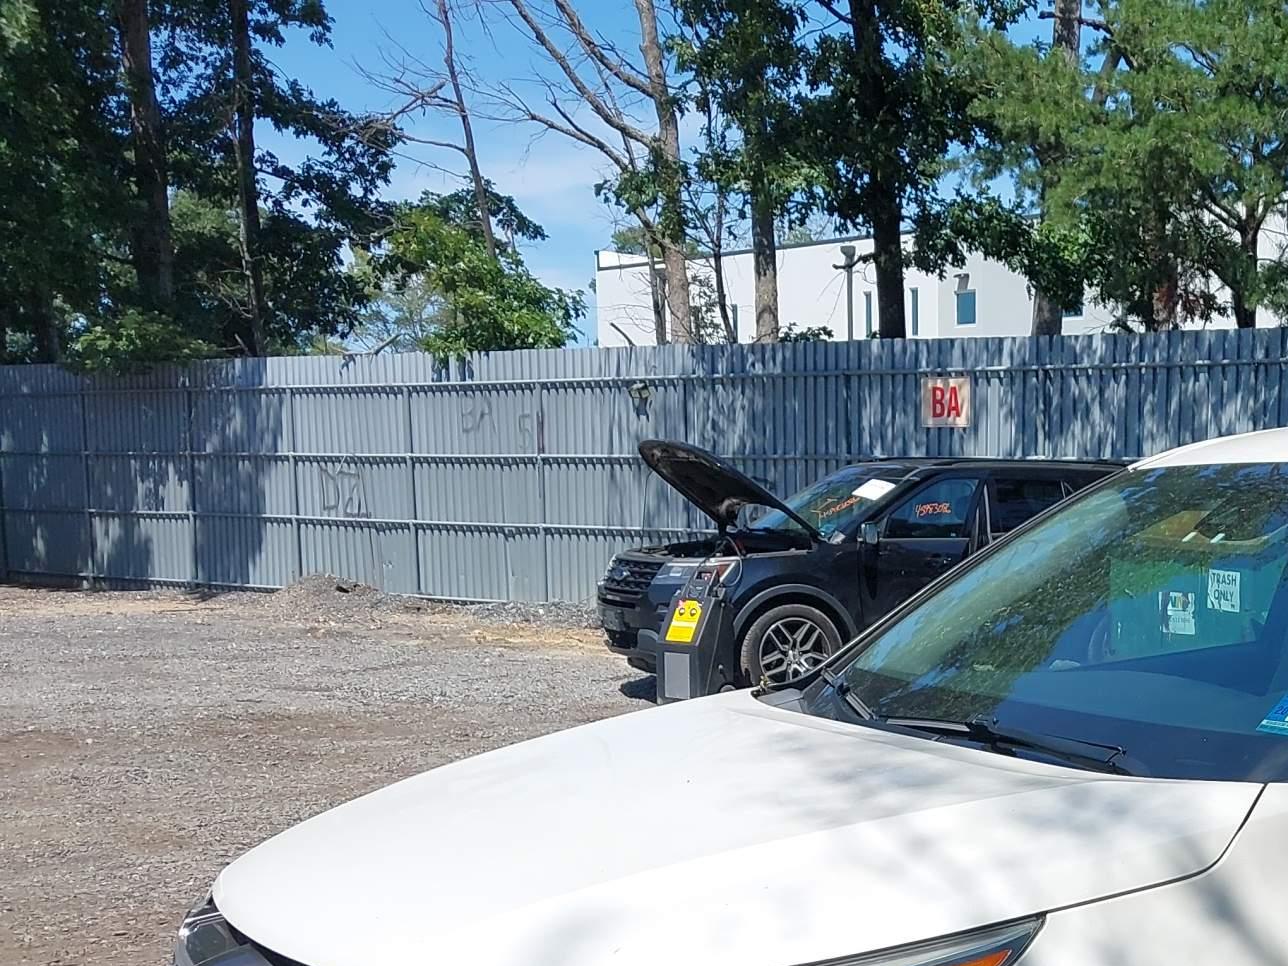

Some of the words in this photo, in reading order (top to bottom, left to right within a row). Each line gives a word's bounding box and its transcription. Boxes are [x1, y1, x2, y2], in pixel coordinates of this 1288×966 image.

[932, 386, 961, 418] BA
[1210, 572, 1237, 588] TRASH
[1213, 589, 1234, 602] ONLY
